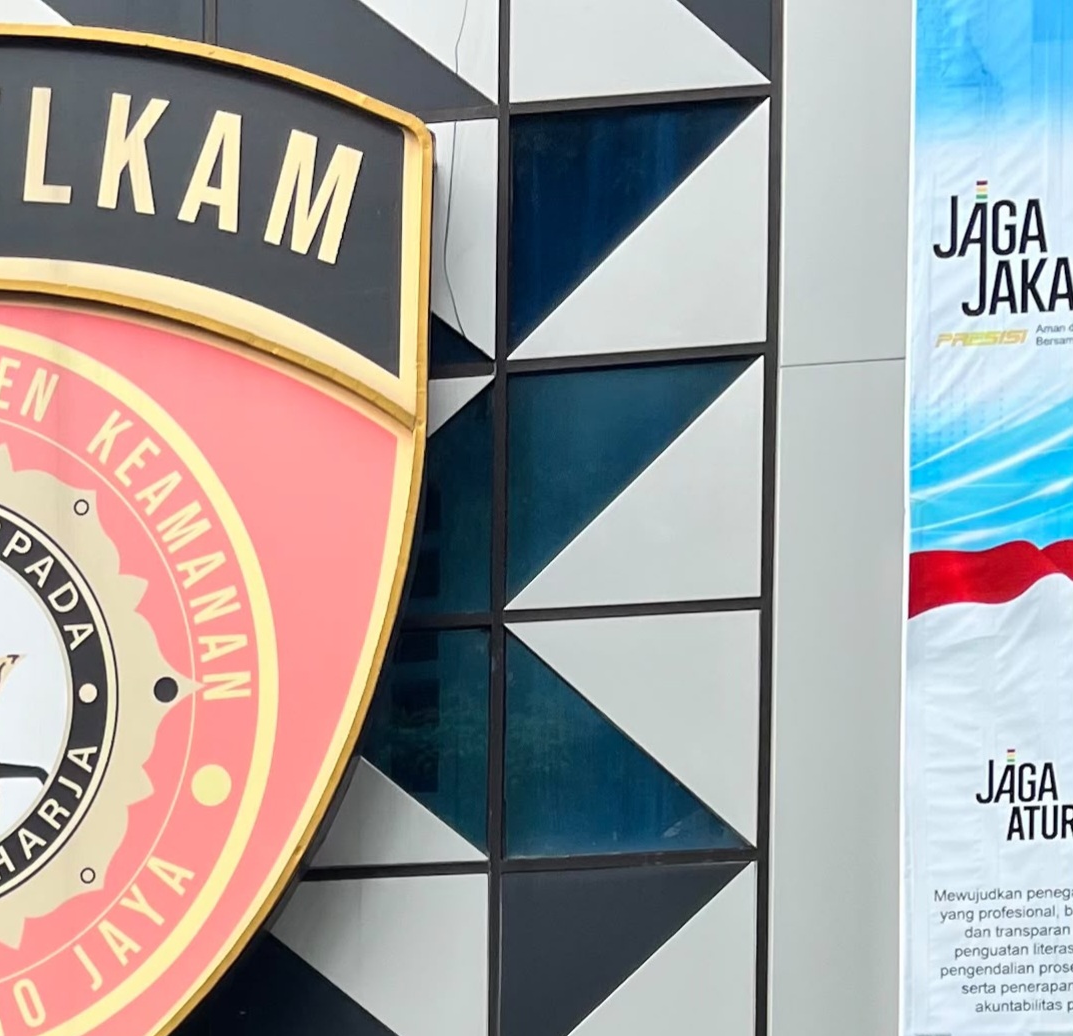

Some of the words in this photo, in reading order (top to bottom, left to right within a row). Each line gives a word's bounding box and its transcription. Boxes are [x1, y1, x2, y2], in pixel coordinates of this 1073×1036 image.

[933, 195, 1048, 259] JAGA
[87, 409, 252, 700] KEAMANAN
[976, 760, 1058, 804] JAGA
[1007, 804, 1073, 841] ATUR
[934, 888, 1023, 904] Mewujudkan
[85, 854, 196, 990] JAYA
[940, 909, 974, 924] yang
[978, 905, 1060, 922] profesional,
[964, 926, 991, 938] dan
[995, 925, 1071, 939] transparan
[954, 944, 1029, 960] penguatan
[940, 962, 1034, 979] pengendalian
[961, 982, 996, 995] serta
[975, 1000, 1063, 1013] akuntabilitas
